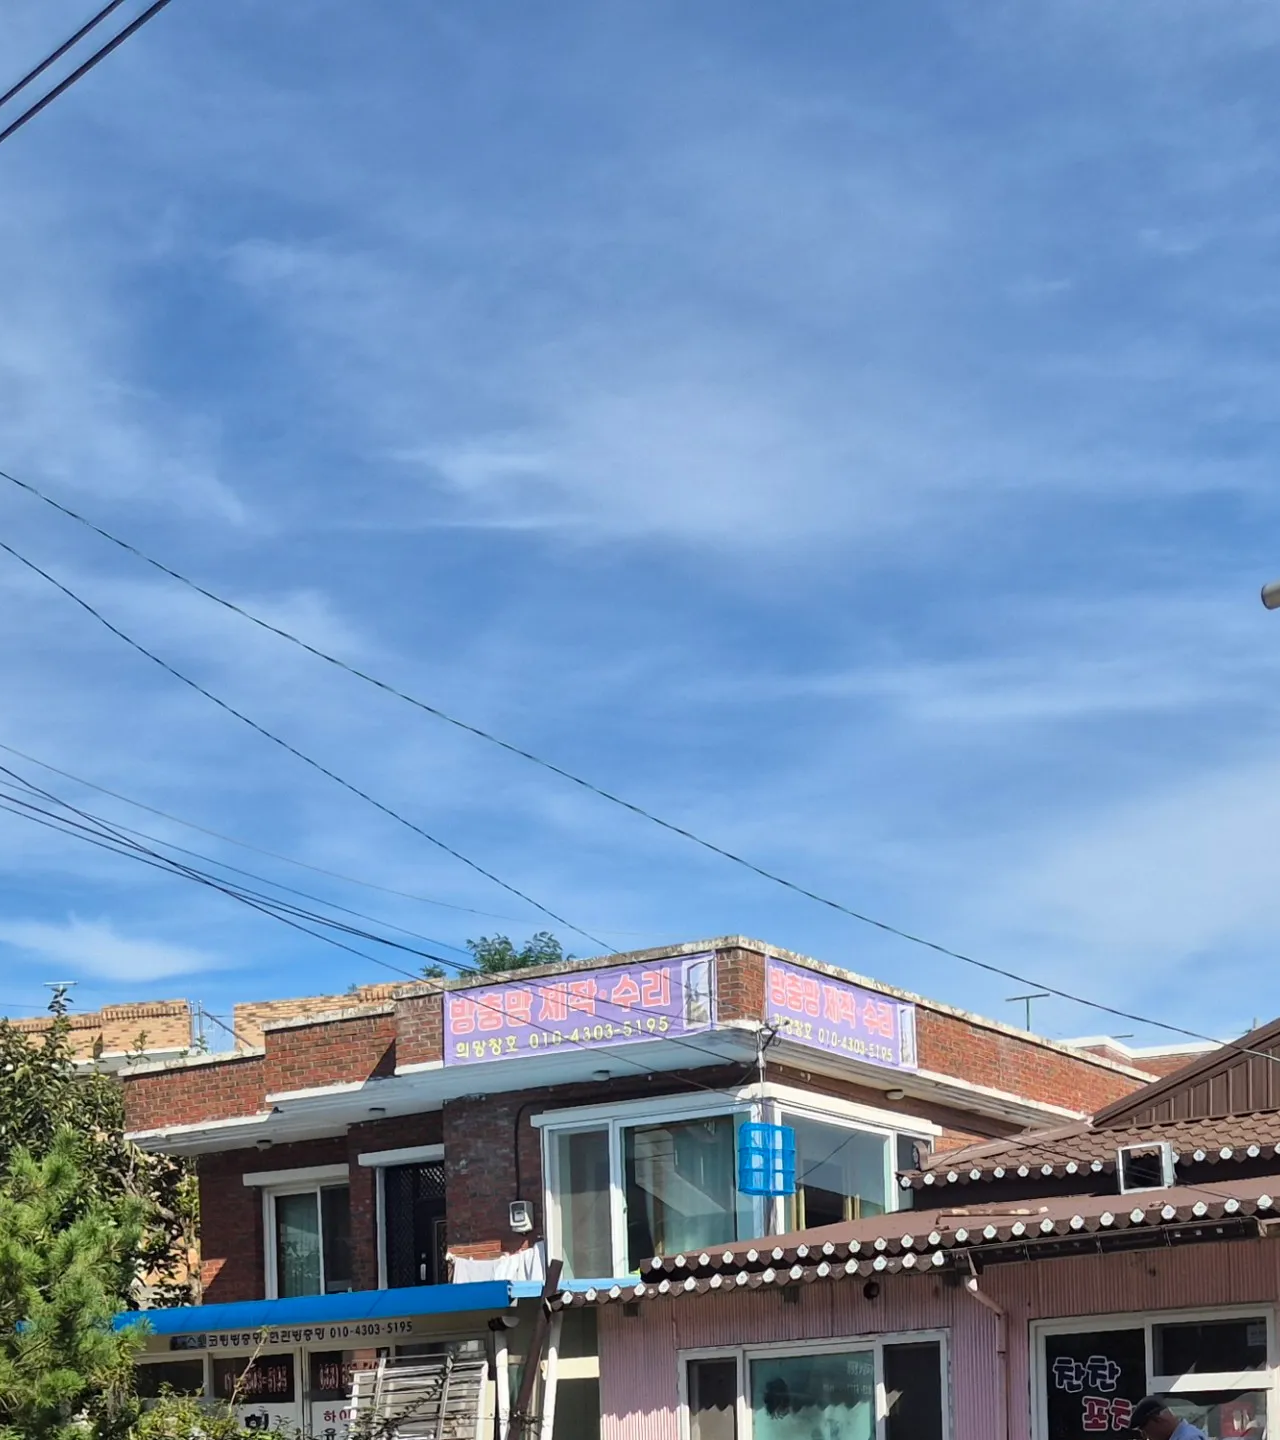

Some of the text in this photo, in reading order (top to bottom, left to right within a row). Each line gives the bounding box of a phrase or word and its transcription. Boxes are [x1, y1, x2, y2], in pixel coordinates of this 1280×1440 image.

[769, 966, 821, 1018] 방충망
[450, 988, 533, 1034] 방충망
[528, 1016, 670, 1049] 010-4303-5195
[818, 1028, 893, 1062] 010-4303-5195
[329, 1321, 413, 1338] 010-4303-5195
